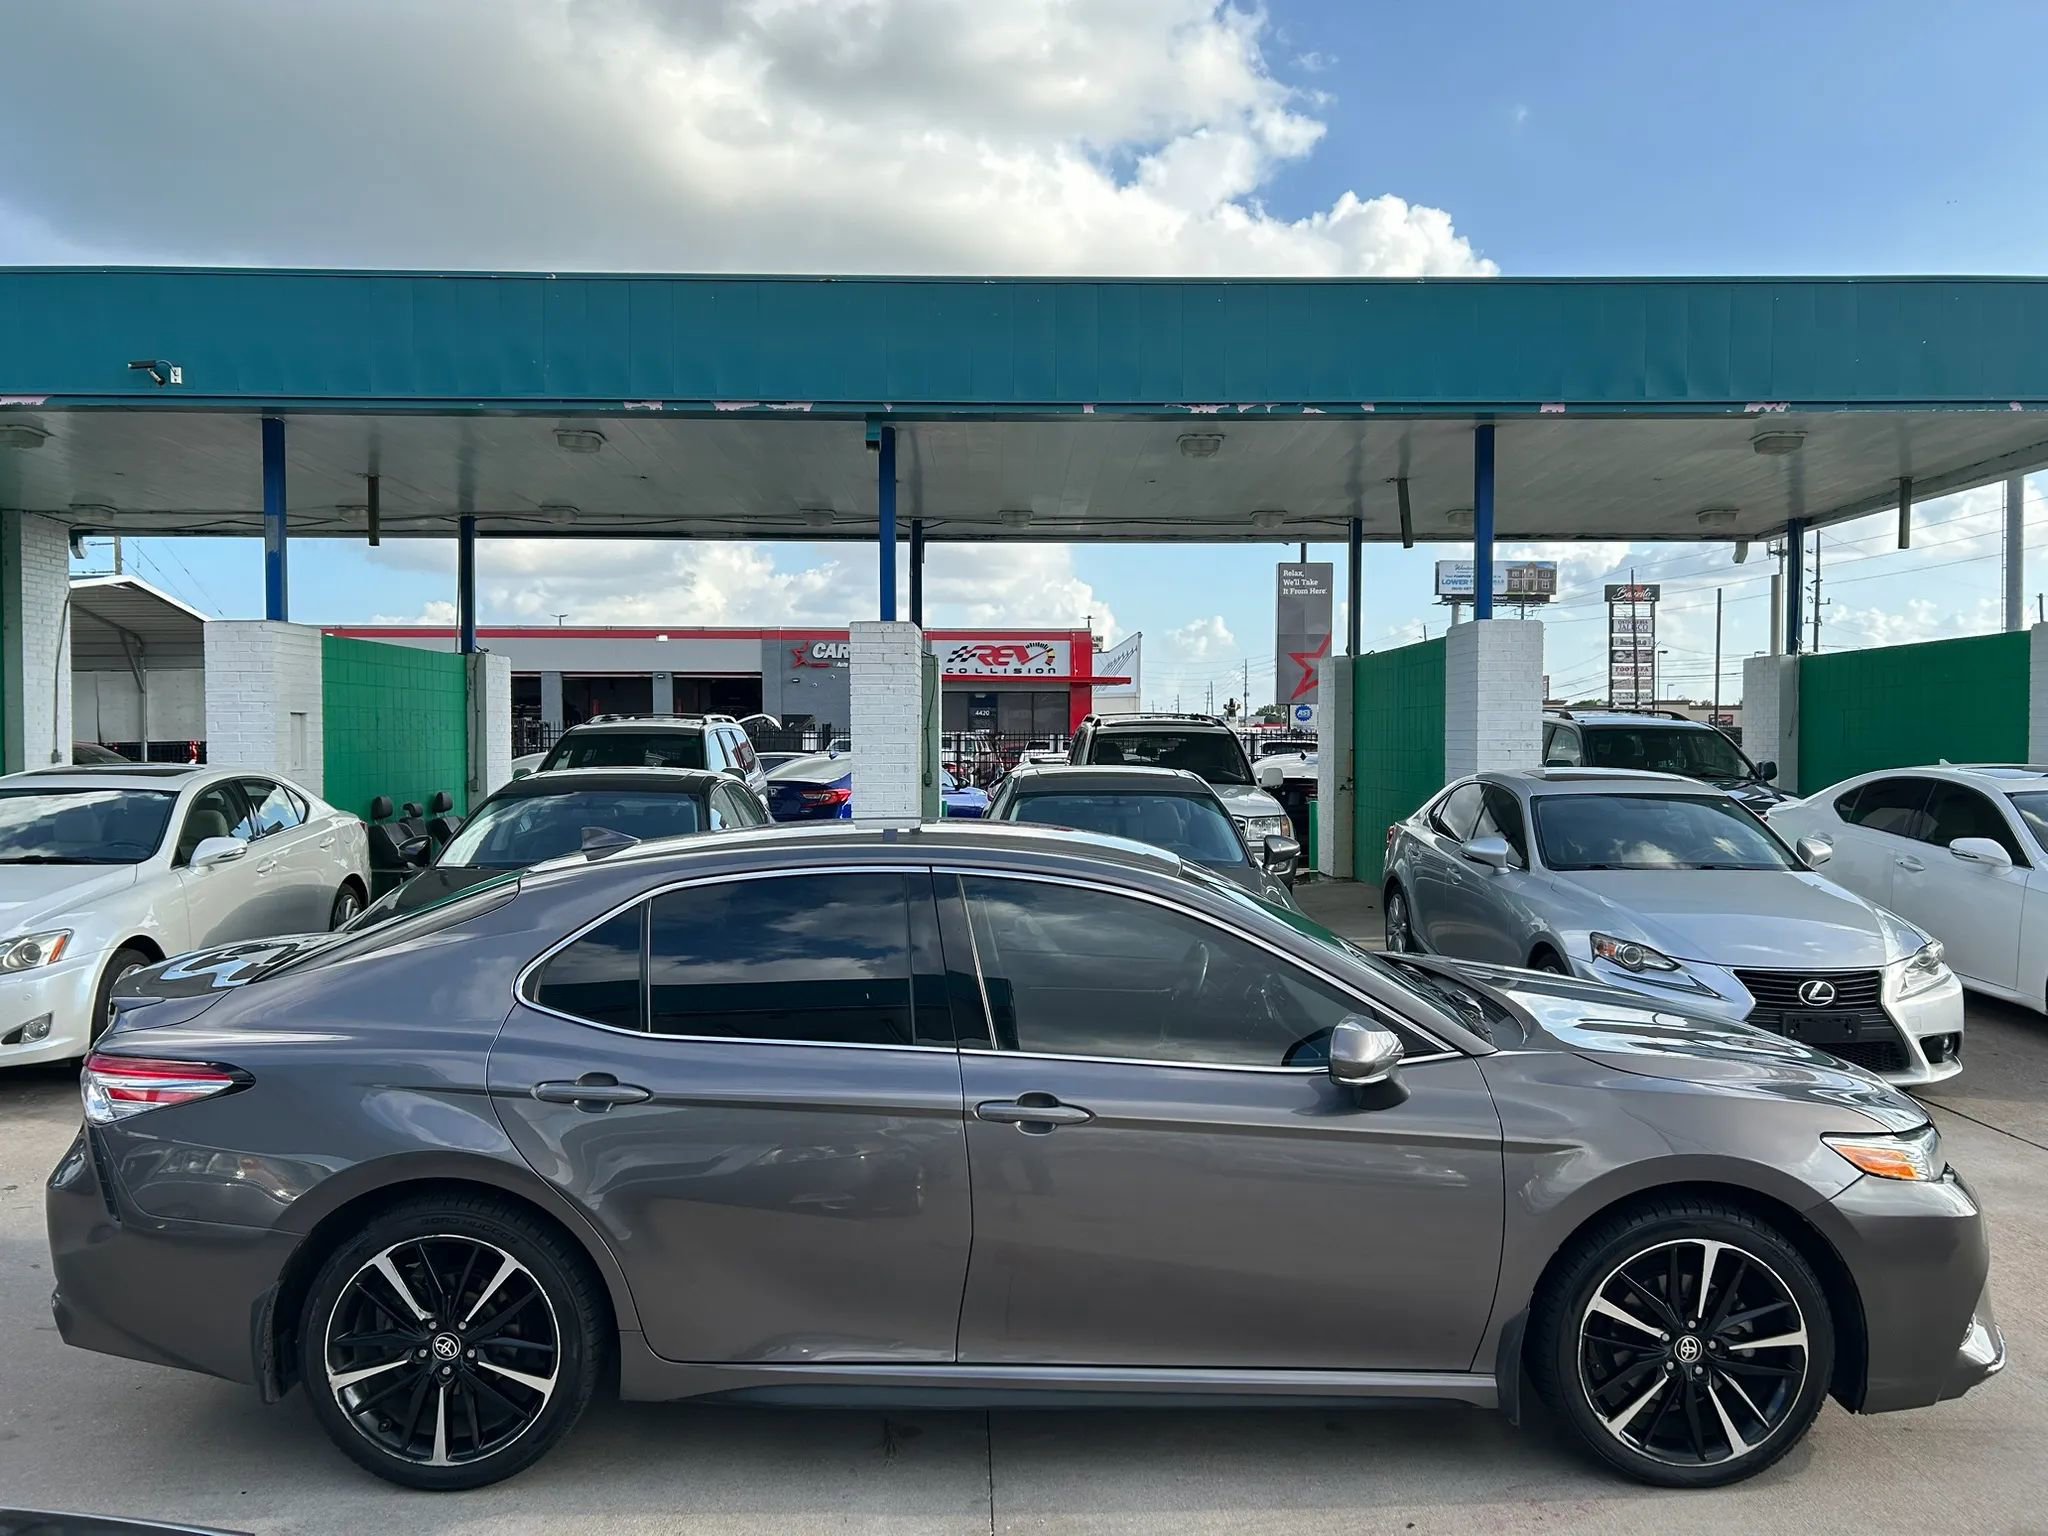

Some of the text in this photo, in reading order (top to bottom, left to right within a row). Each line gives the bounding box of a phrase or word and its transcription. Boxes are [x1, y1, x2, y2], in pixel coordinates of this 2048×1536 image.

[1283, 569, 1304, 577] Relax,
[1283, 578, 1318, 586] We'll Take
[973, 645, 1040, 666] REV
